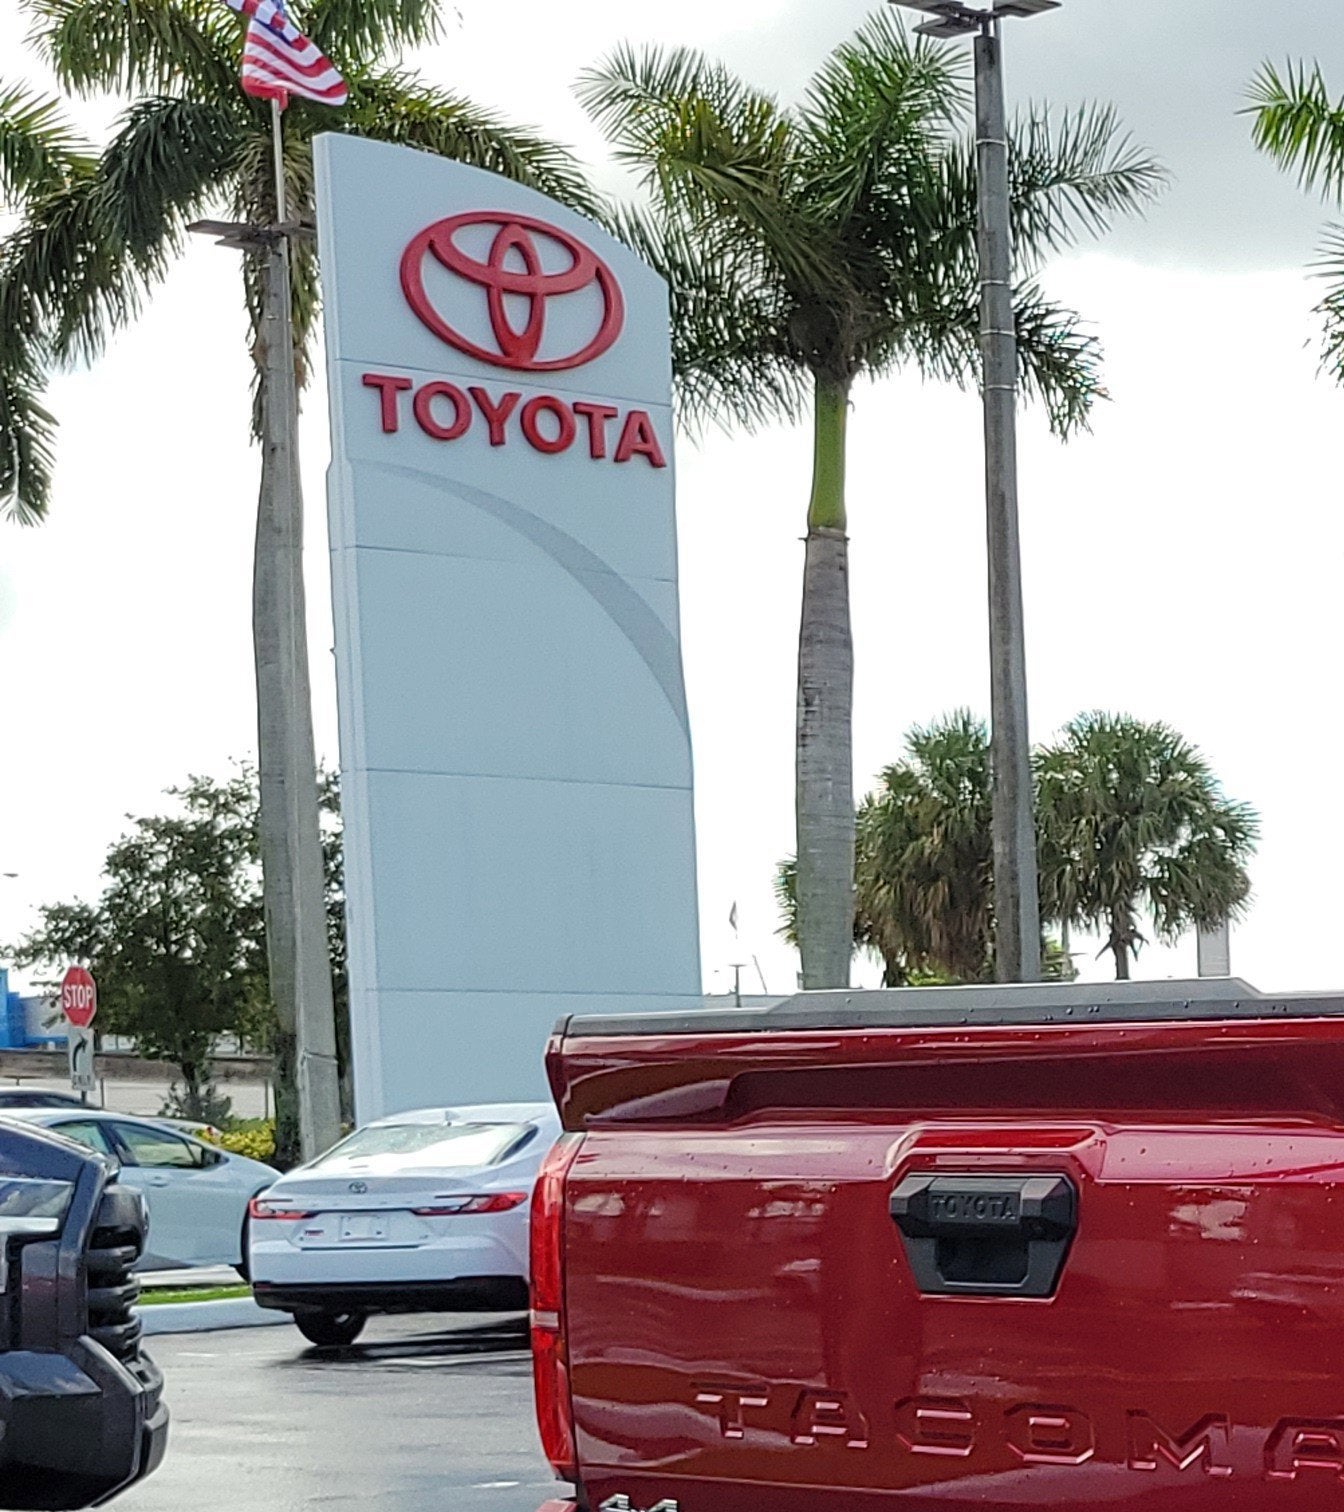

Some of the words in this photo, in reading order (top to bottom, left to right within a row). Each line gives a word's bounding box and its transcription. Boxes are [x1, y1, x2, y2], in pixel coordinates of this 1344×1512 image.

[362, 373, 667, 468] TOYOTA
[64, 984, 93, 1009] STOP
[929, 1195, 1017, 1221] TOYOTA
